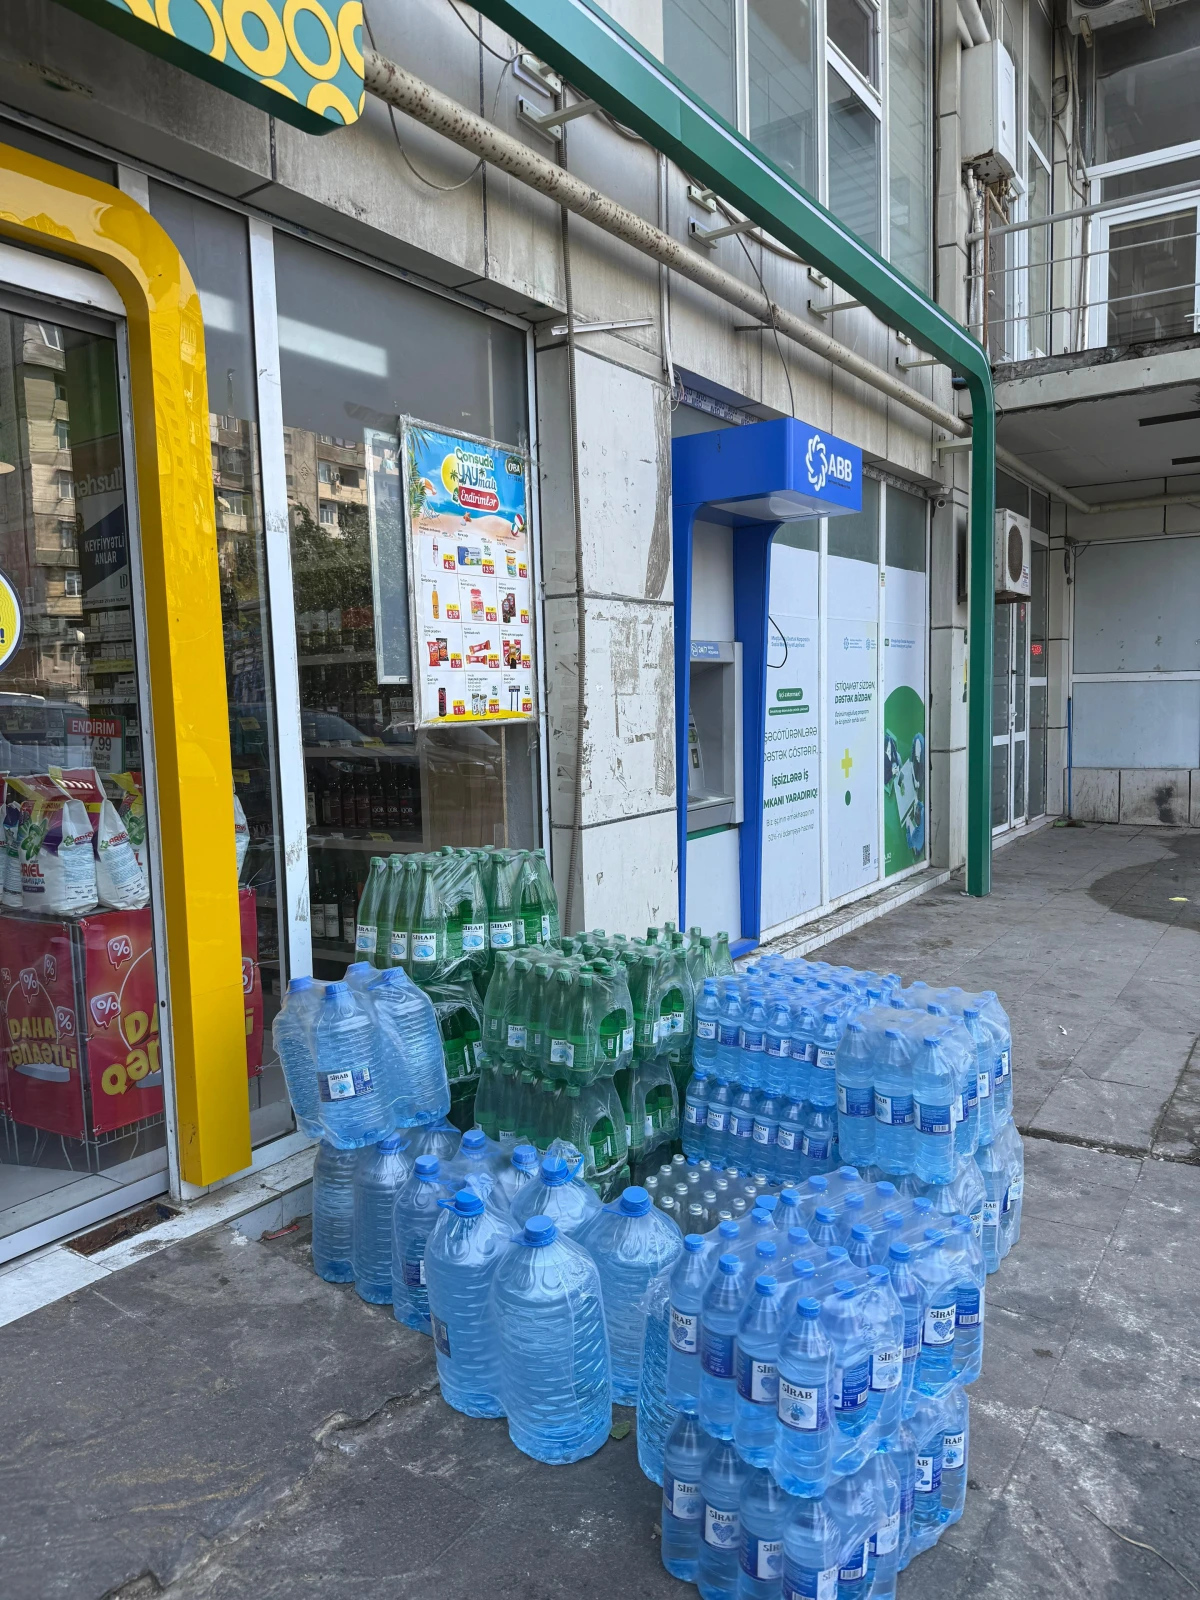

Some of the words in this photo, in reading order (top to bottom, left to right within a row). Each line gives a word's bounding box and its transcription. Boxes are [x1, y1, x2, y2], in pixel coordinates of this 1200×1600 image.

[828, 453, 852, 482] ABB
[460, 490, 497, 507] Endirimlər
[84, 533, 125, 553] KEYFİYYƏTLİ
[94, 550, 118, 566] ANLAR
[835, 694, 853, 704] DƏSTƏK
[72, 719, 115, 735] ENDİRİM
[82, 736, 111, 751] 17.99
[771, 770, 803, 789] İŞSİZLƏRƏ
[803, 768, 809, 782] İŞ
[109, 831, 128, 844] ARIEL
[9, 1015, 57, 1040] DAHA
[329, 1072, 349, 1081] SİRAB
[782, 1383, 813, 1400] SİRAB
[945, 1436, 963, 1445] RAB
[709, 1508, 738, 1522] SİRAB
